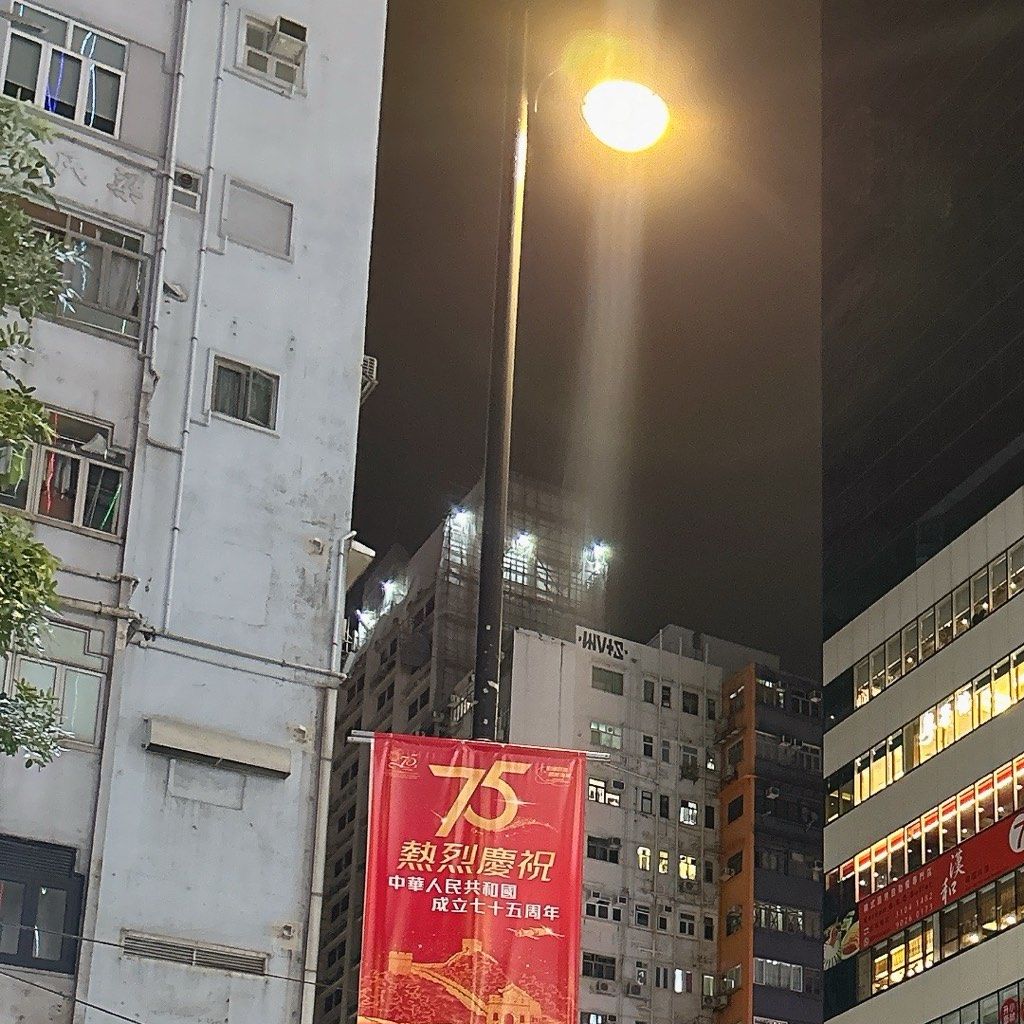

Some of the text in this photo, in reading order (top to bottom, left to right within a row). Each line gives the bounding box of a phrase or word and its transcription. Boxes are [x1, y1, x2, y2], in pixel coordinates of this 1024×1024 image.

[429, 760, 532, 838] 75
[398, 840, 555, 882] 熱烈慶祝
[389, 875, 517, 901] 中華人民共和國
[432, 896, 560, 921] 成立七十五周年
